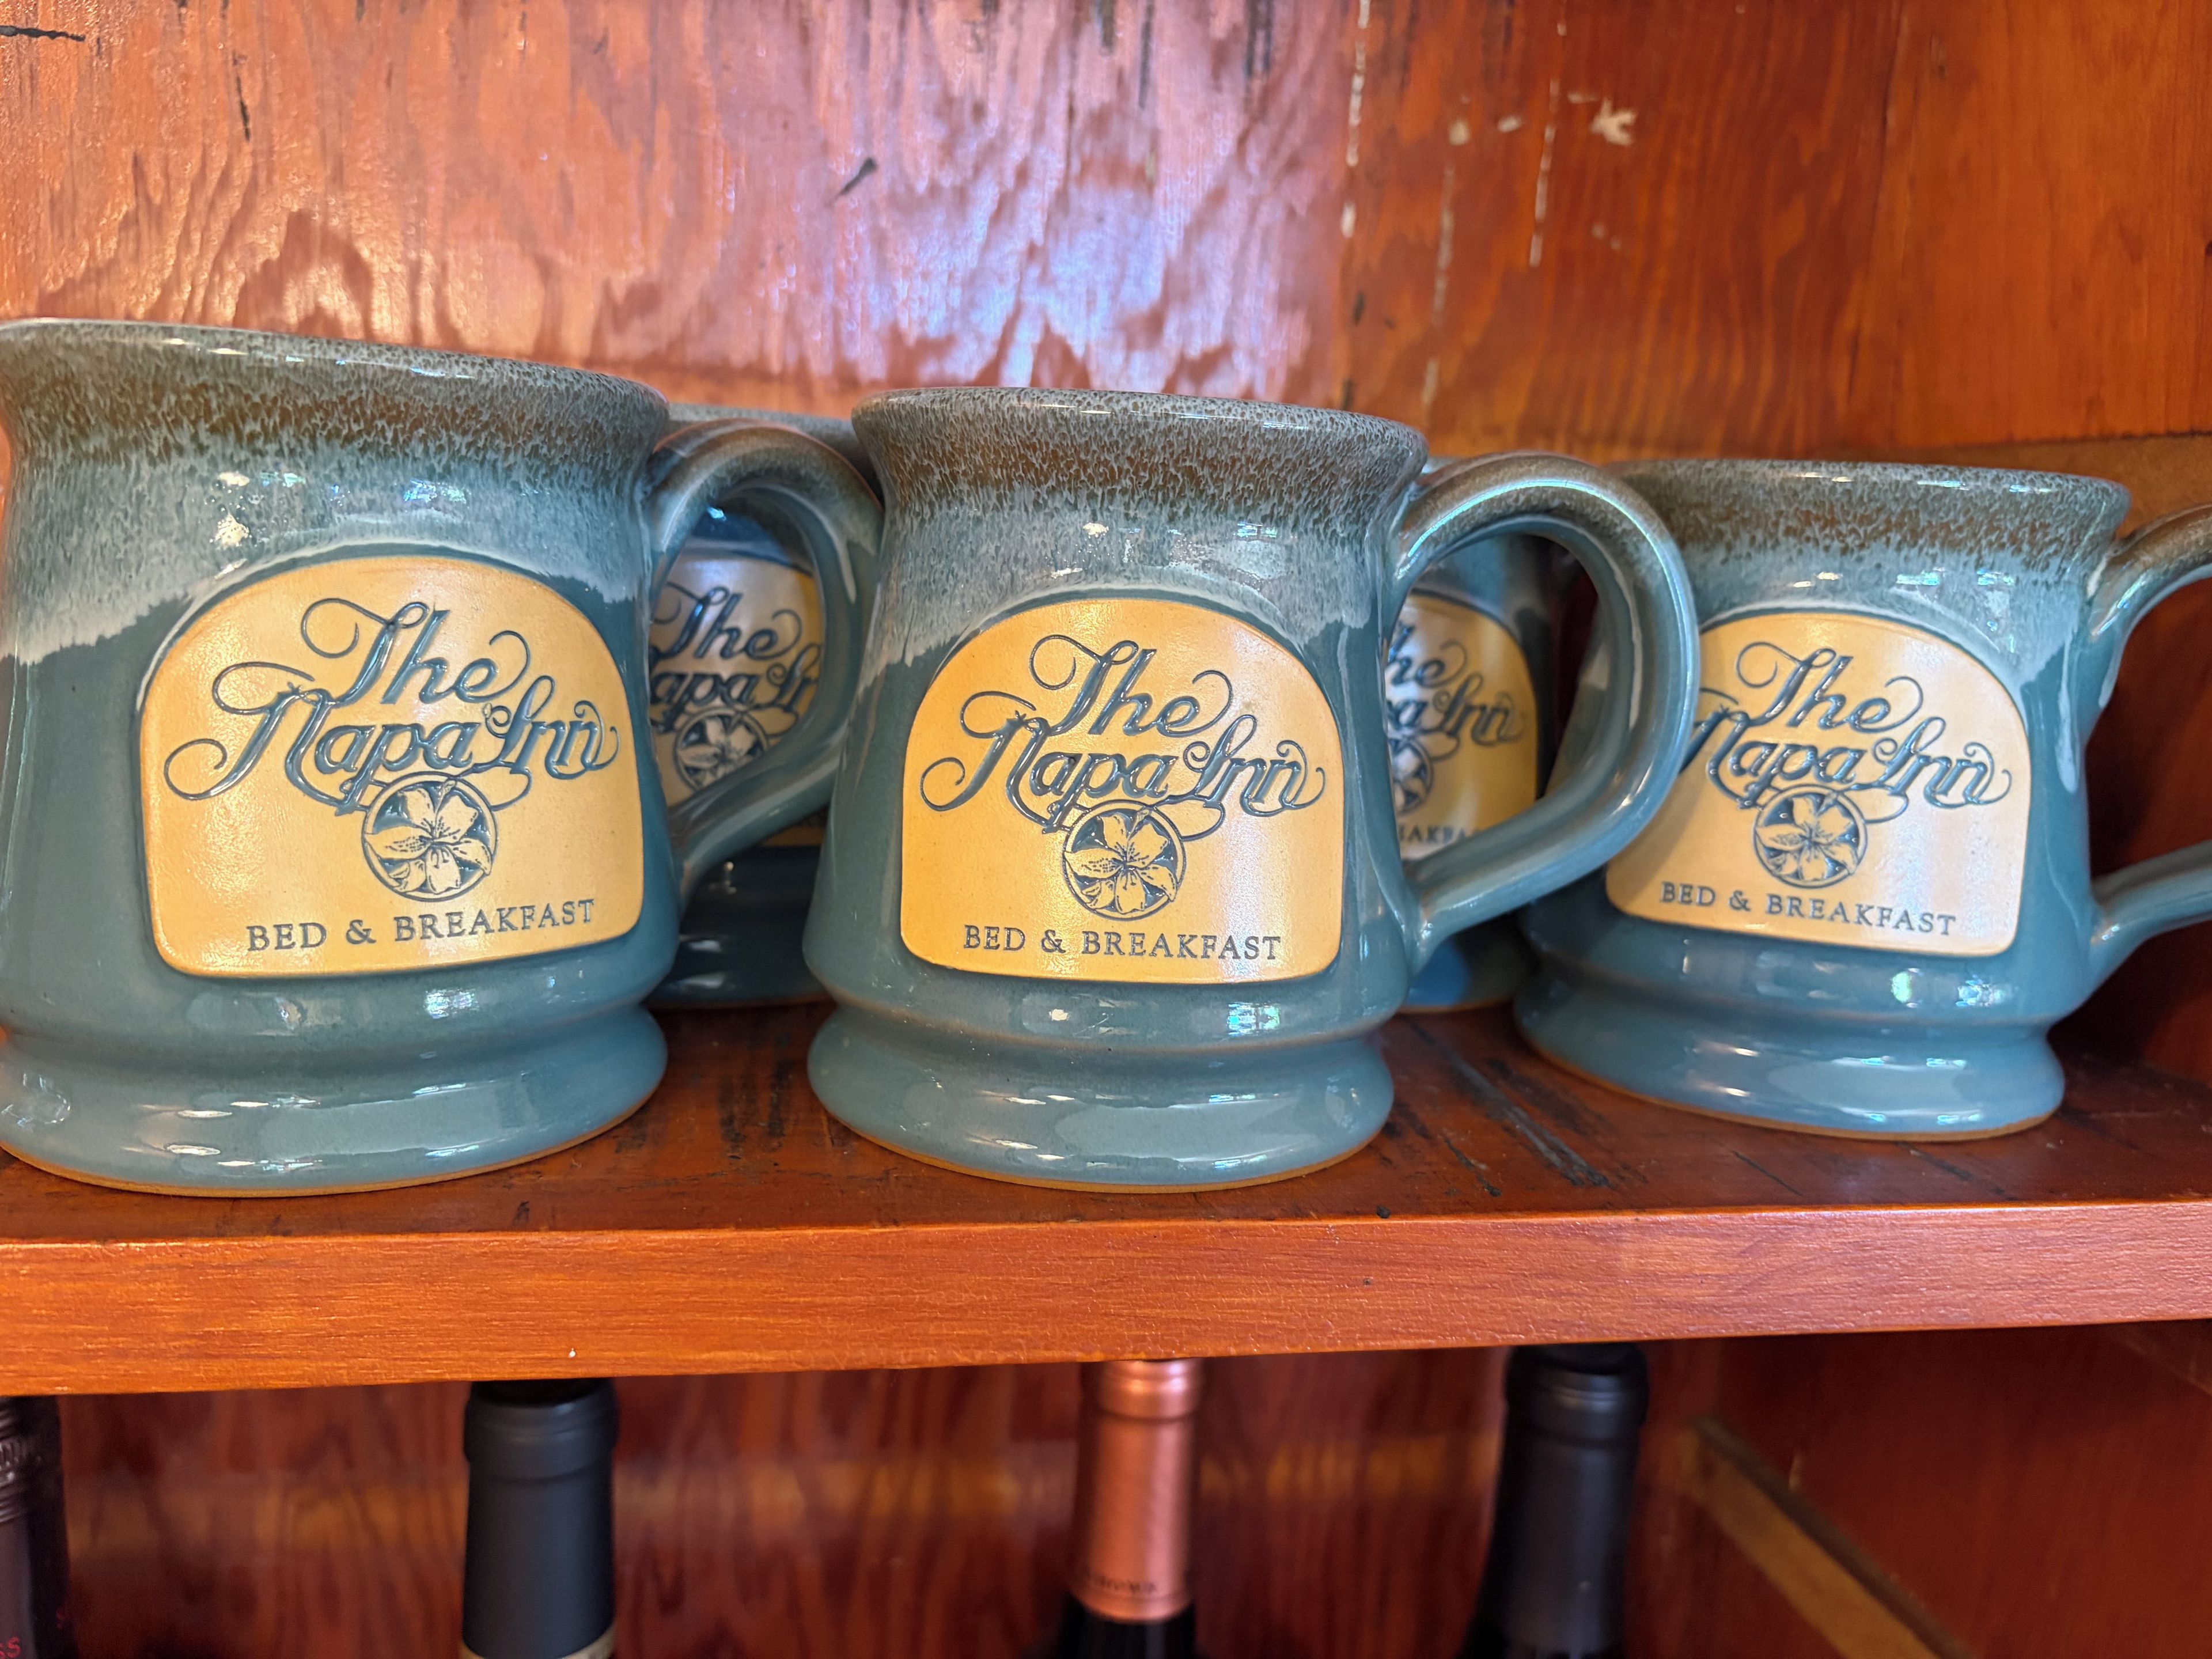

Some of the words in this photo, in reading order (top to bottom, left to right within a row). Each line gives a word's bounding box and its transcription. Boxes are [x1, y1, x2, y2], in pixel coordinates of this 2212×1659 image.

[301, 597, 531, 705] The
[1030, 634, 1233, 738] The
[1388, 620, 1468, 688] he
[1736, 641, 1924, 733] The
[164, 661, 480, 816] Napa
[467, 675, 619, 811] Inn
[649, 671, 760, 735] apa
[921, 691, 1179, 834] Napa
[1166, 714, 1325, 842] Inn
[1855, 716, 2012, 824] Inn
[247, 922, 327, 952] BED
[345, 919, 376, 945] &
[393, 899, 595, 943] BREAKFAST
[963, 925, 1026, 952] BED
[1041, 929, 1063, 953] &
[1081, 930, 1281, 961] BREAKFAST
[1660, 881, 1717, 907] BED
[1729, 890, 1752, 912] &
[1766, 893, 1956, 937] BREAKFAST
